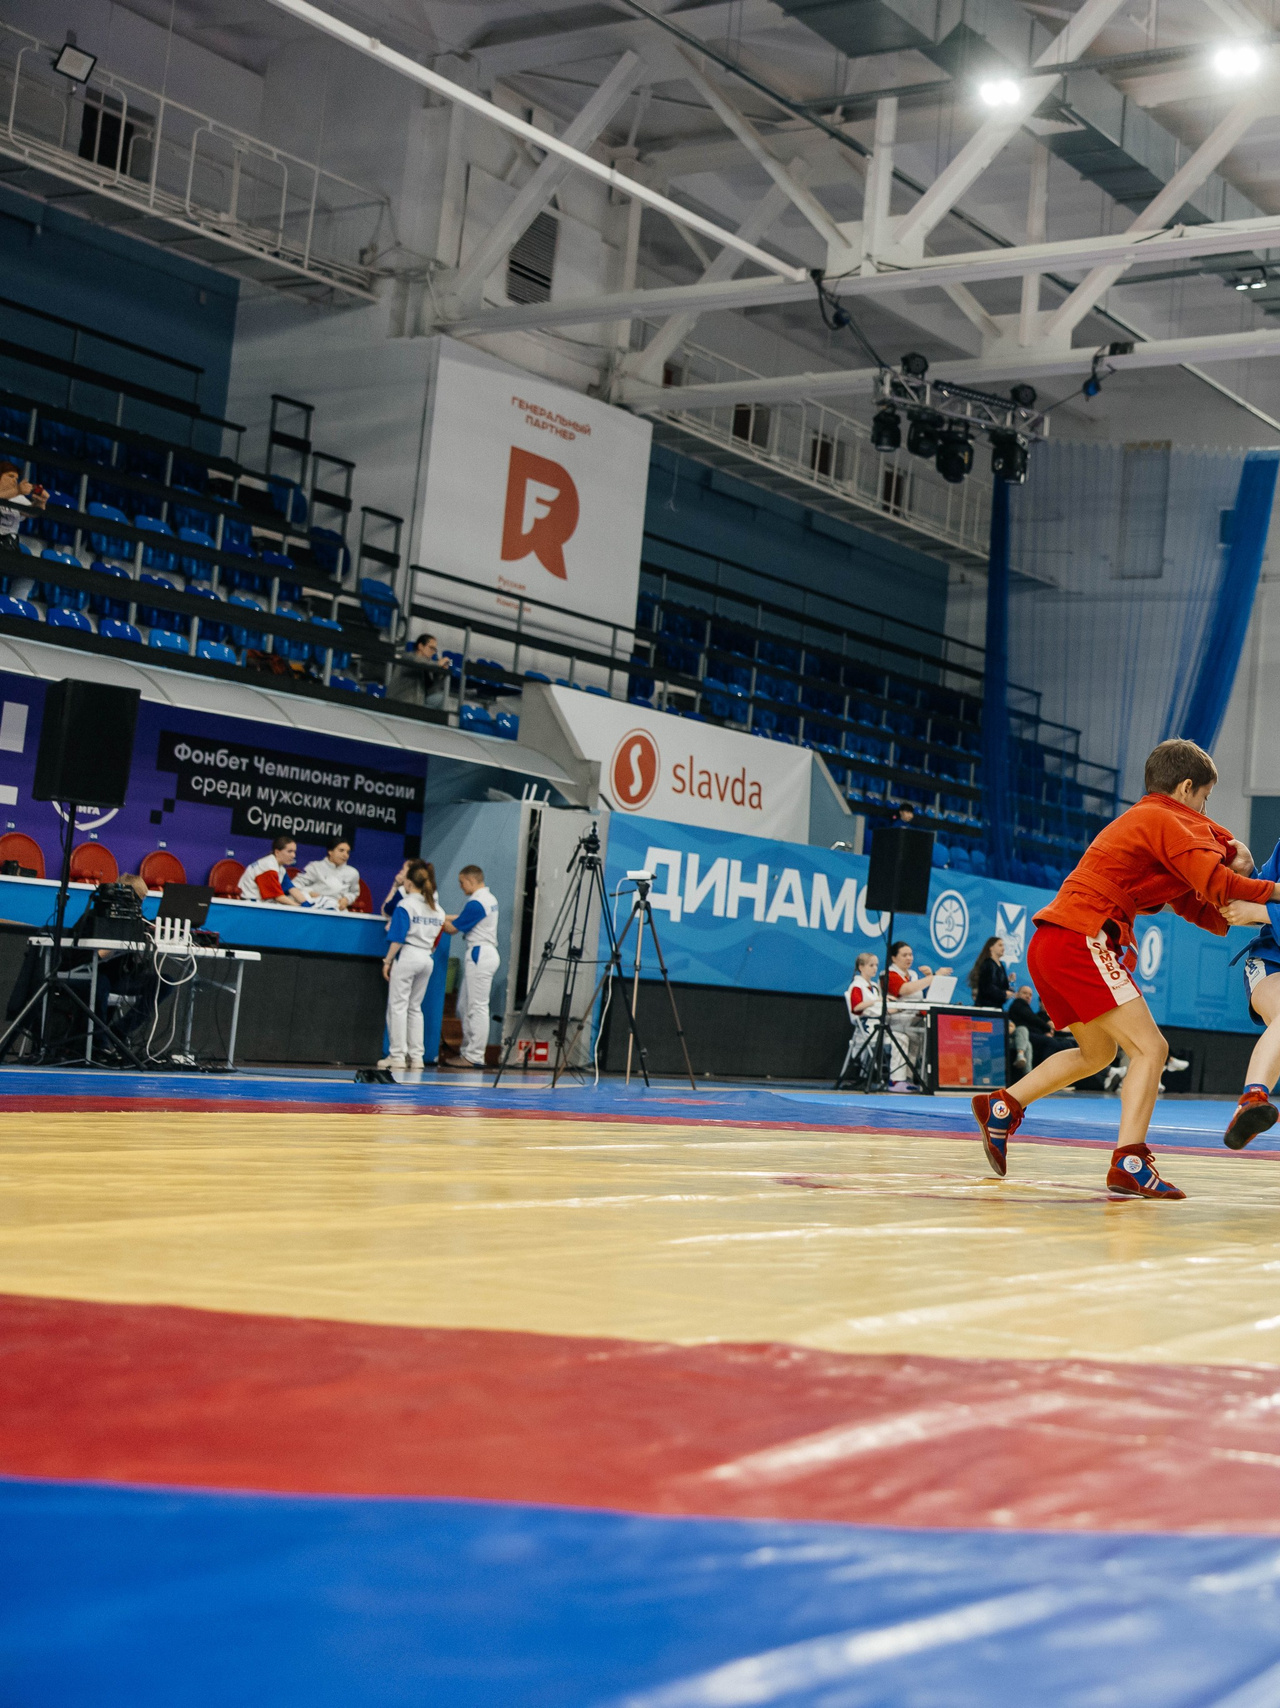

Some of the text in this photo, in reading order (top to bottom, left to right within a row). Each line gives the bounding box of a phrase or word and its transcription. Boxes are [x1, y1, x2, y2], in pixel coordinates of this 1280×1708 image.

[525, 414, 576, 441] ПАРТНЕР
[174, 743, 415, 800] Фонбет Чемпионат России
[672, 755, 762, 810] slavda
[191, 776, 396, 824] среди мужских команд
[247, 806, 342, 837] Суперлиги
